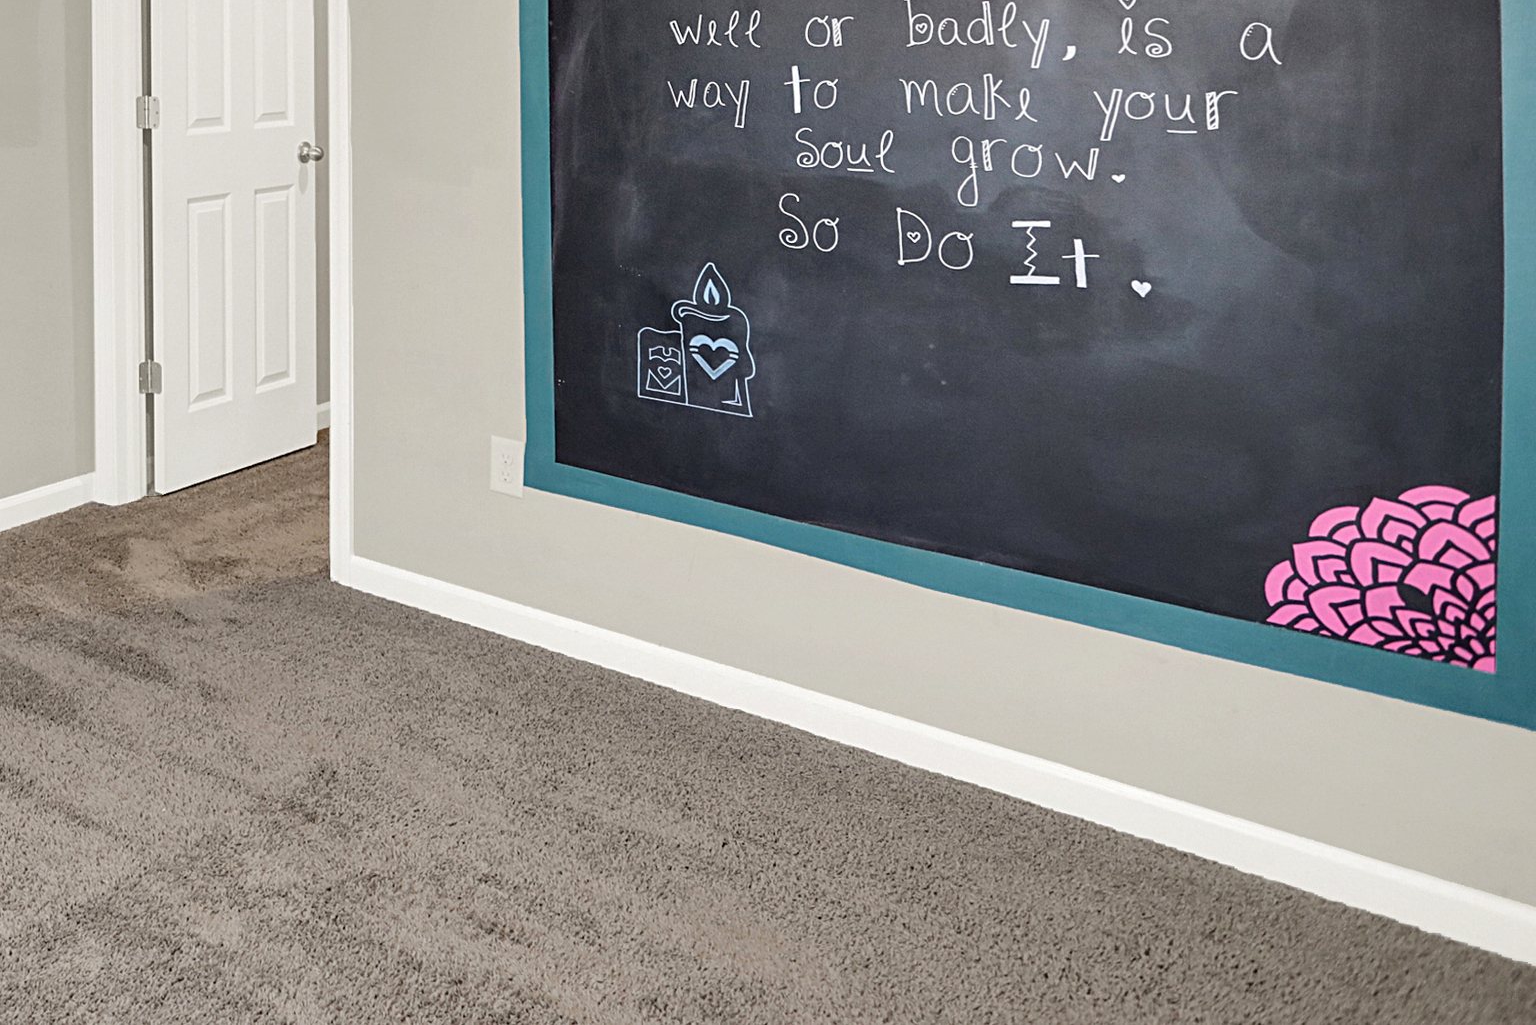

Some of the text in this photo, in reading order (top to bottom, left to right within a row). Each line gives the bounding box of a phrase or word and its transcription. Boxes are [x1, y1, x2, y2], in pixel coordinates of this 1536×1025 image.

[669, 9, 761, 49] well
[804, 15, 855, 48] or
[1239, 21, 1283, 66] a
[666, 64, 1239, 142] way to make your
[778, 192, 840, 253] So
[895, 206, 978, 270] Do
